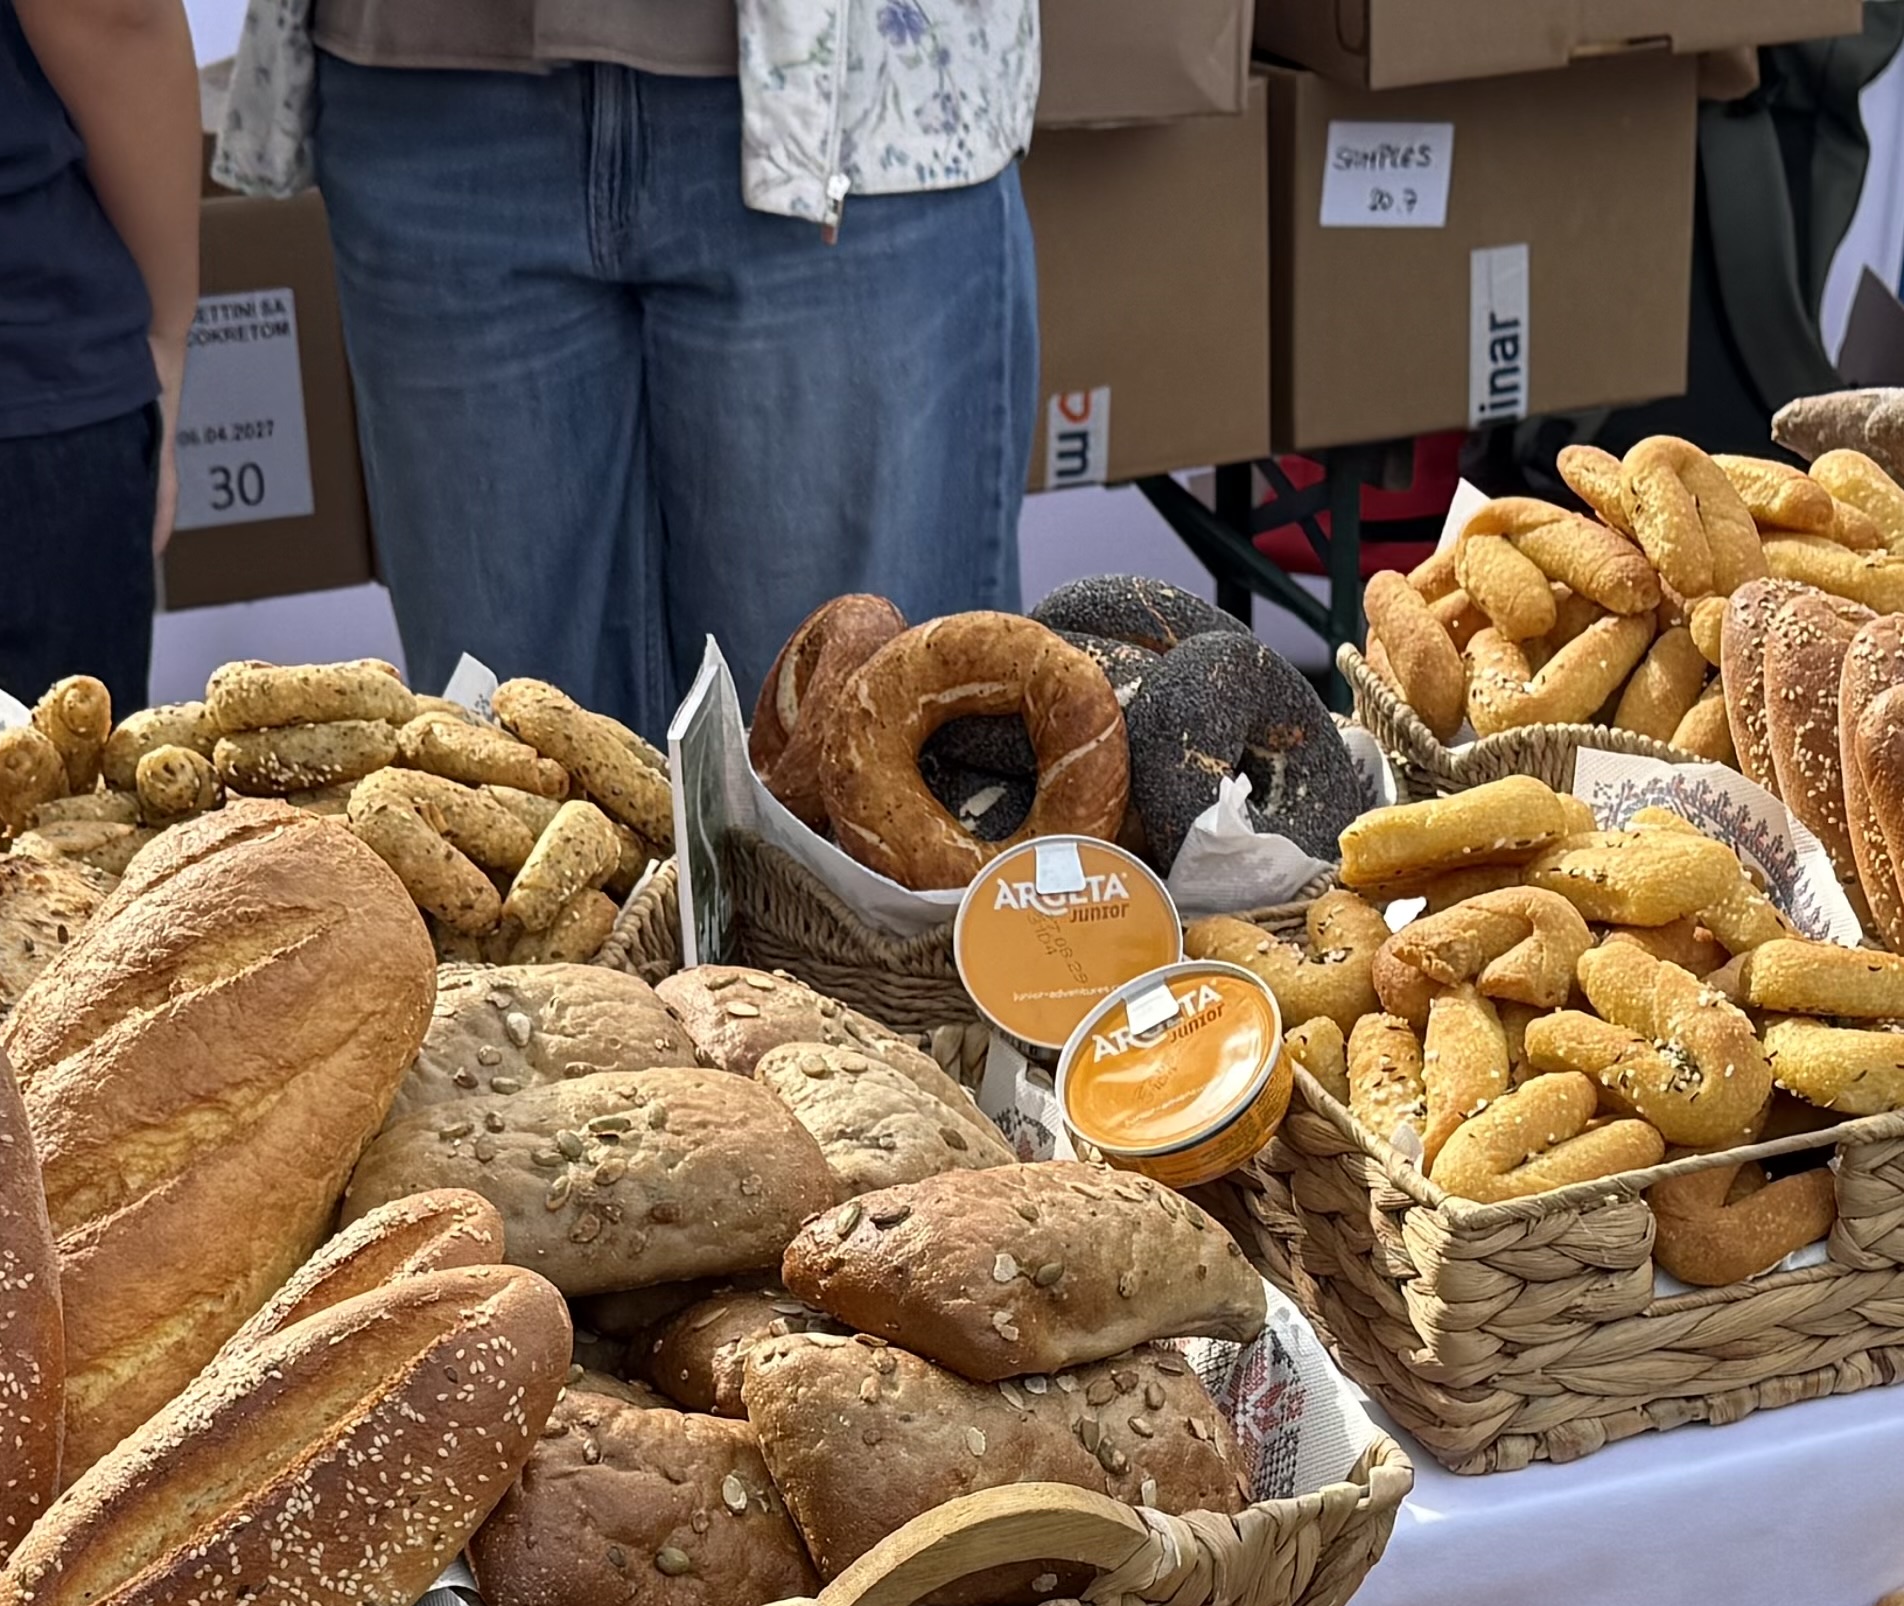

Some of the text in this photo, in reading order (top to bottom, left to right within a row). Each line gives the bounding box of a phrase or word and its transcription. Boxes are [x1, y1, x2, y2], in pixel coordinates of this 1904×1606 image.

[1478, 311, 1520, 425] inar
[208, 461, 266, 511] 30
[1091, 983, 1224, 1064] ARTA
